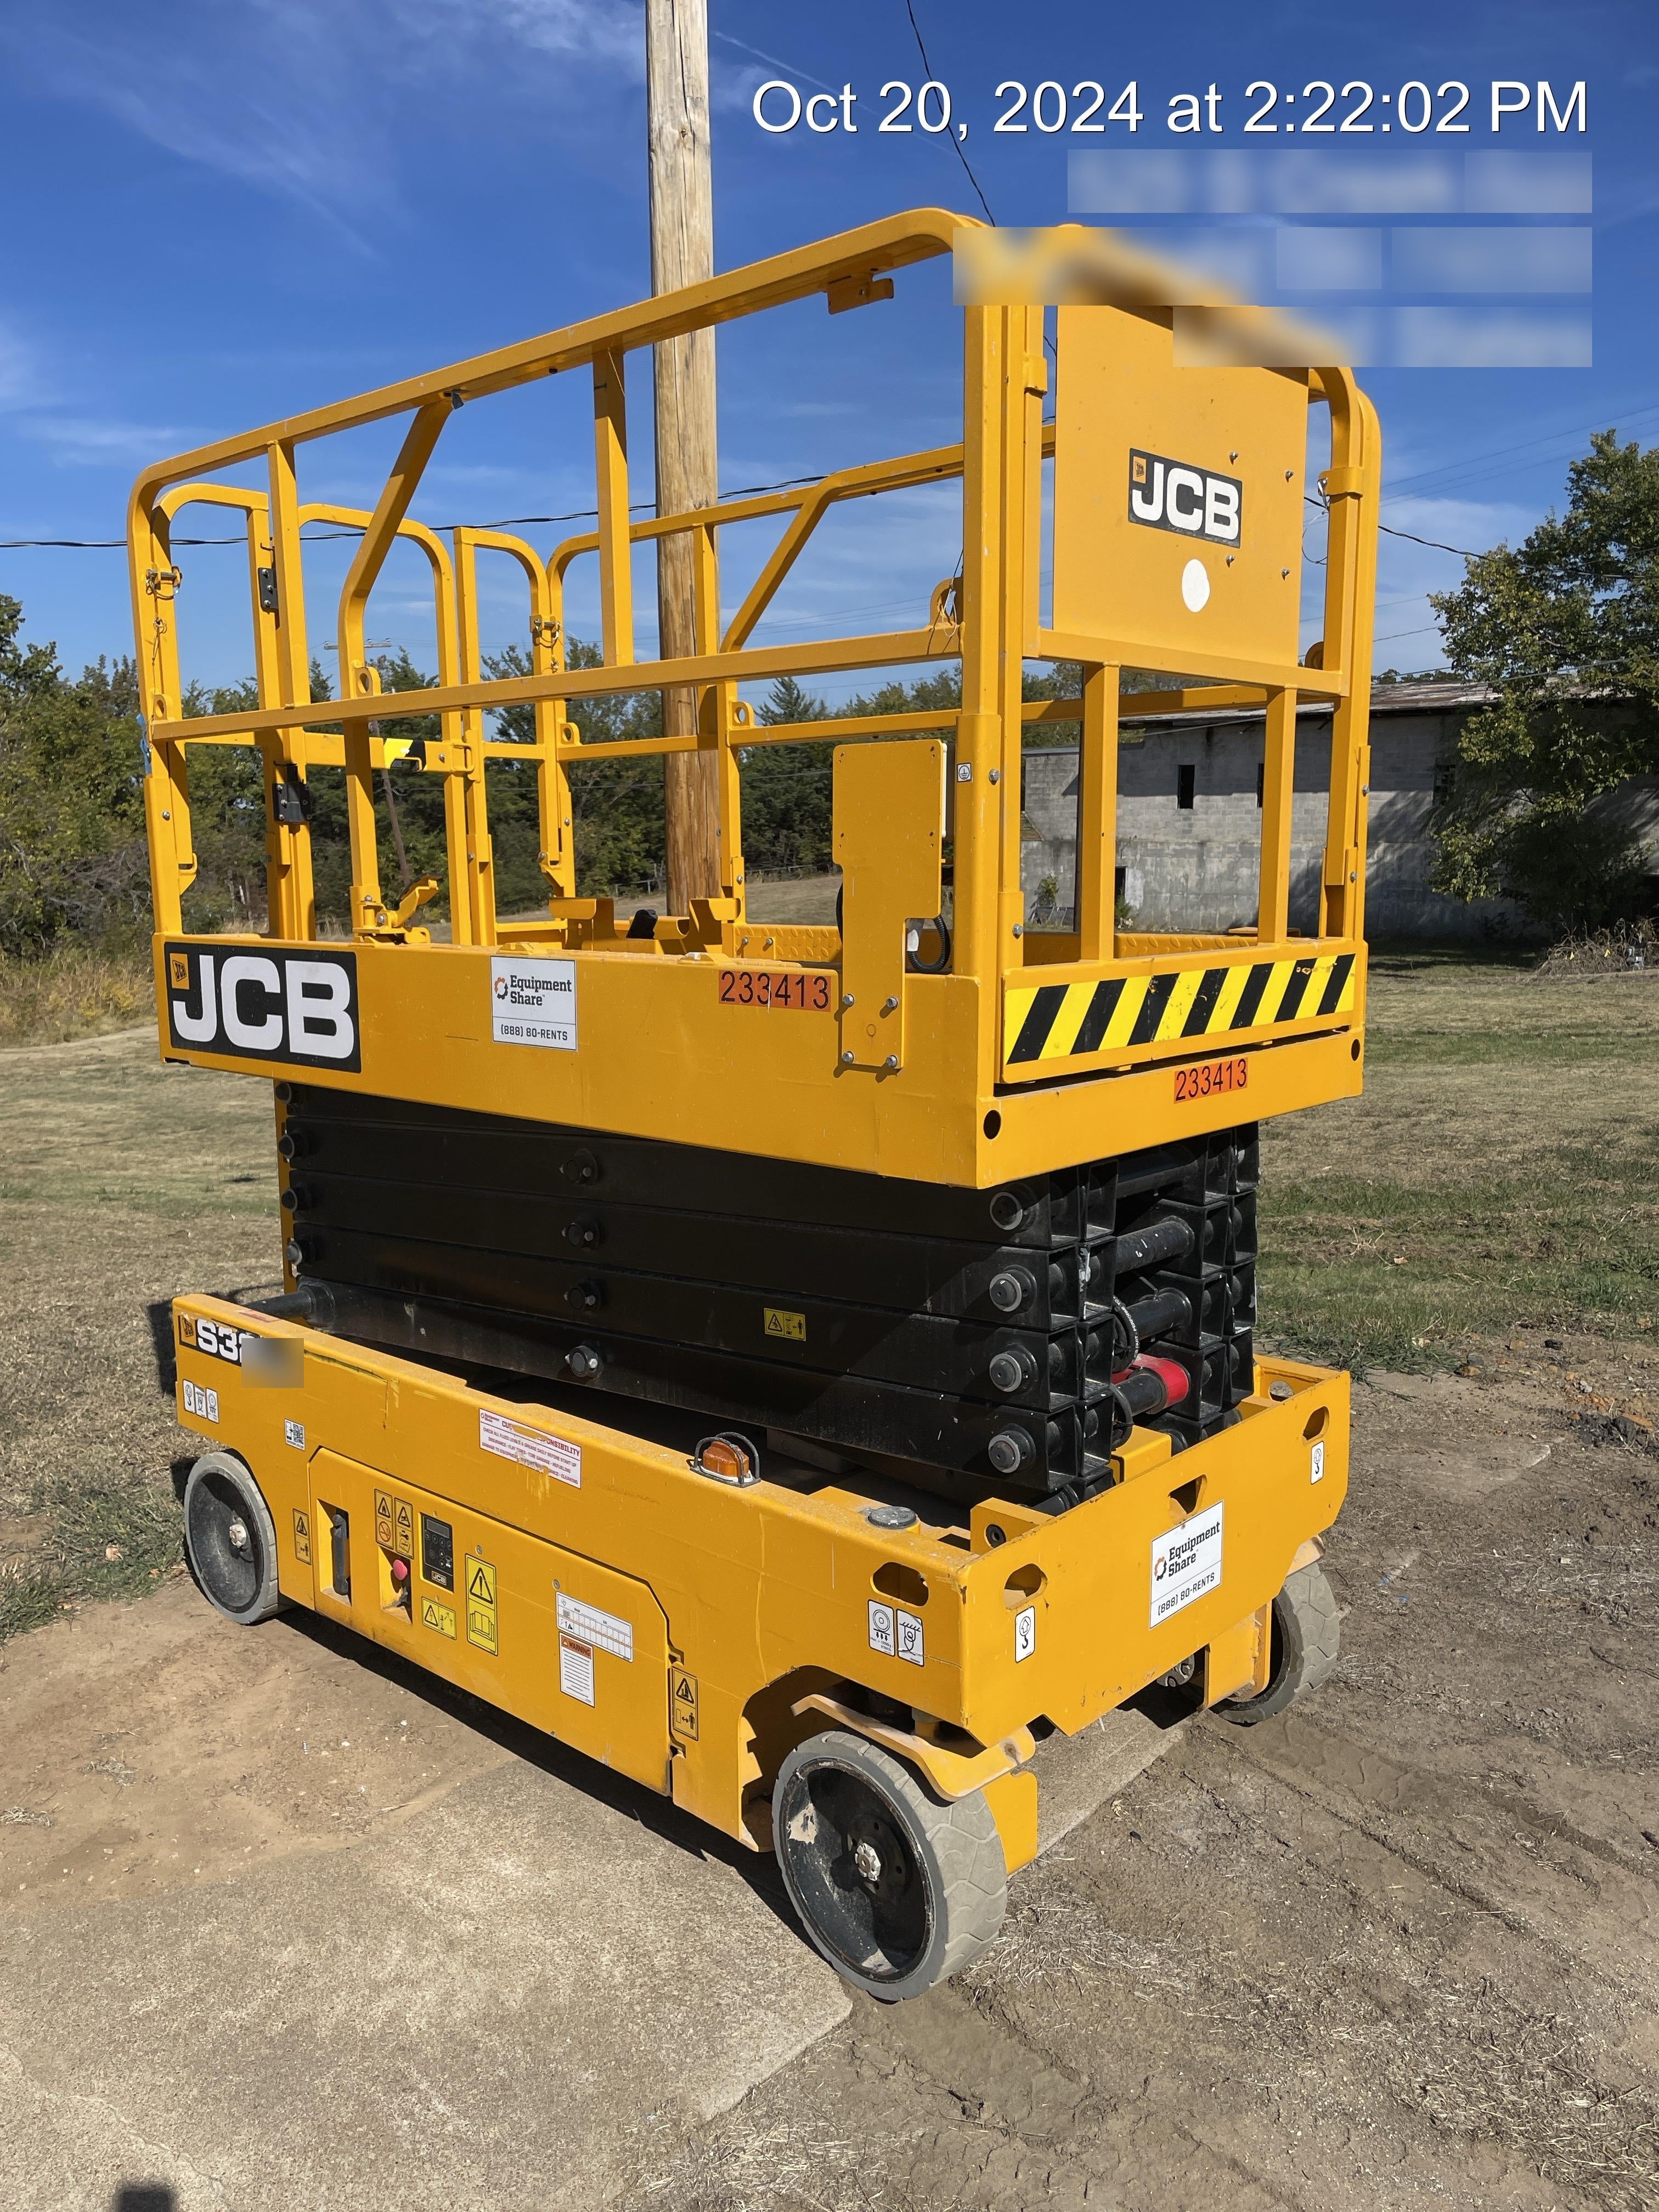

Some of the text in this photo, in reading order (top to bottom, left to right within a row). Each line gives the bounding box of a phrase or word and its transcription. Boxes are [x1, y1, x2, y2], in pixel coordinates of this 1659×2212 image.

[1132, 461, 1239, 540] JCB
[510, 975, 572, 992] Equipment
[510, 991, 543, 1006] Share
[721, 970, 829, 1009] 233413
[172, 955, 354, 1059] JCB
[501, 1024, 568, 1041] (888) 80-RENTS
[1175, 1058, 1247, 1102] 233413
[1169, 1521, 1220, 1562] Equipment
[432, 1573, 445, 1583] JCB
[1168, 1553, 1197, 1577] Share
[1158, 1572, 1215, 1616] (888) 80-RENTS
[569, 1642, 590, 1656] WARNING
